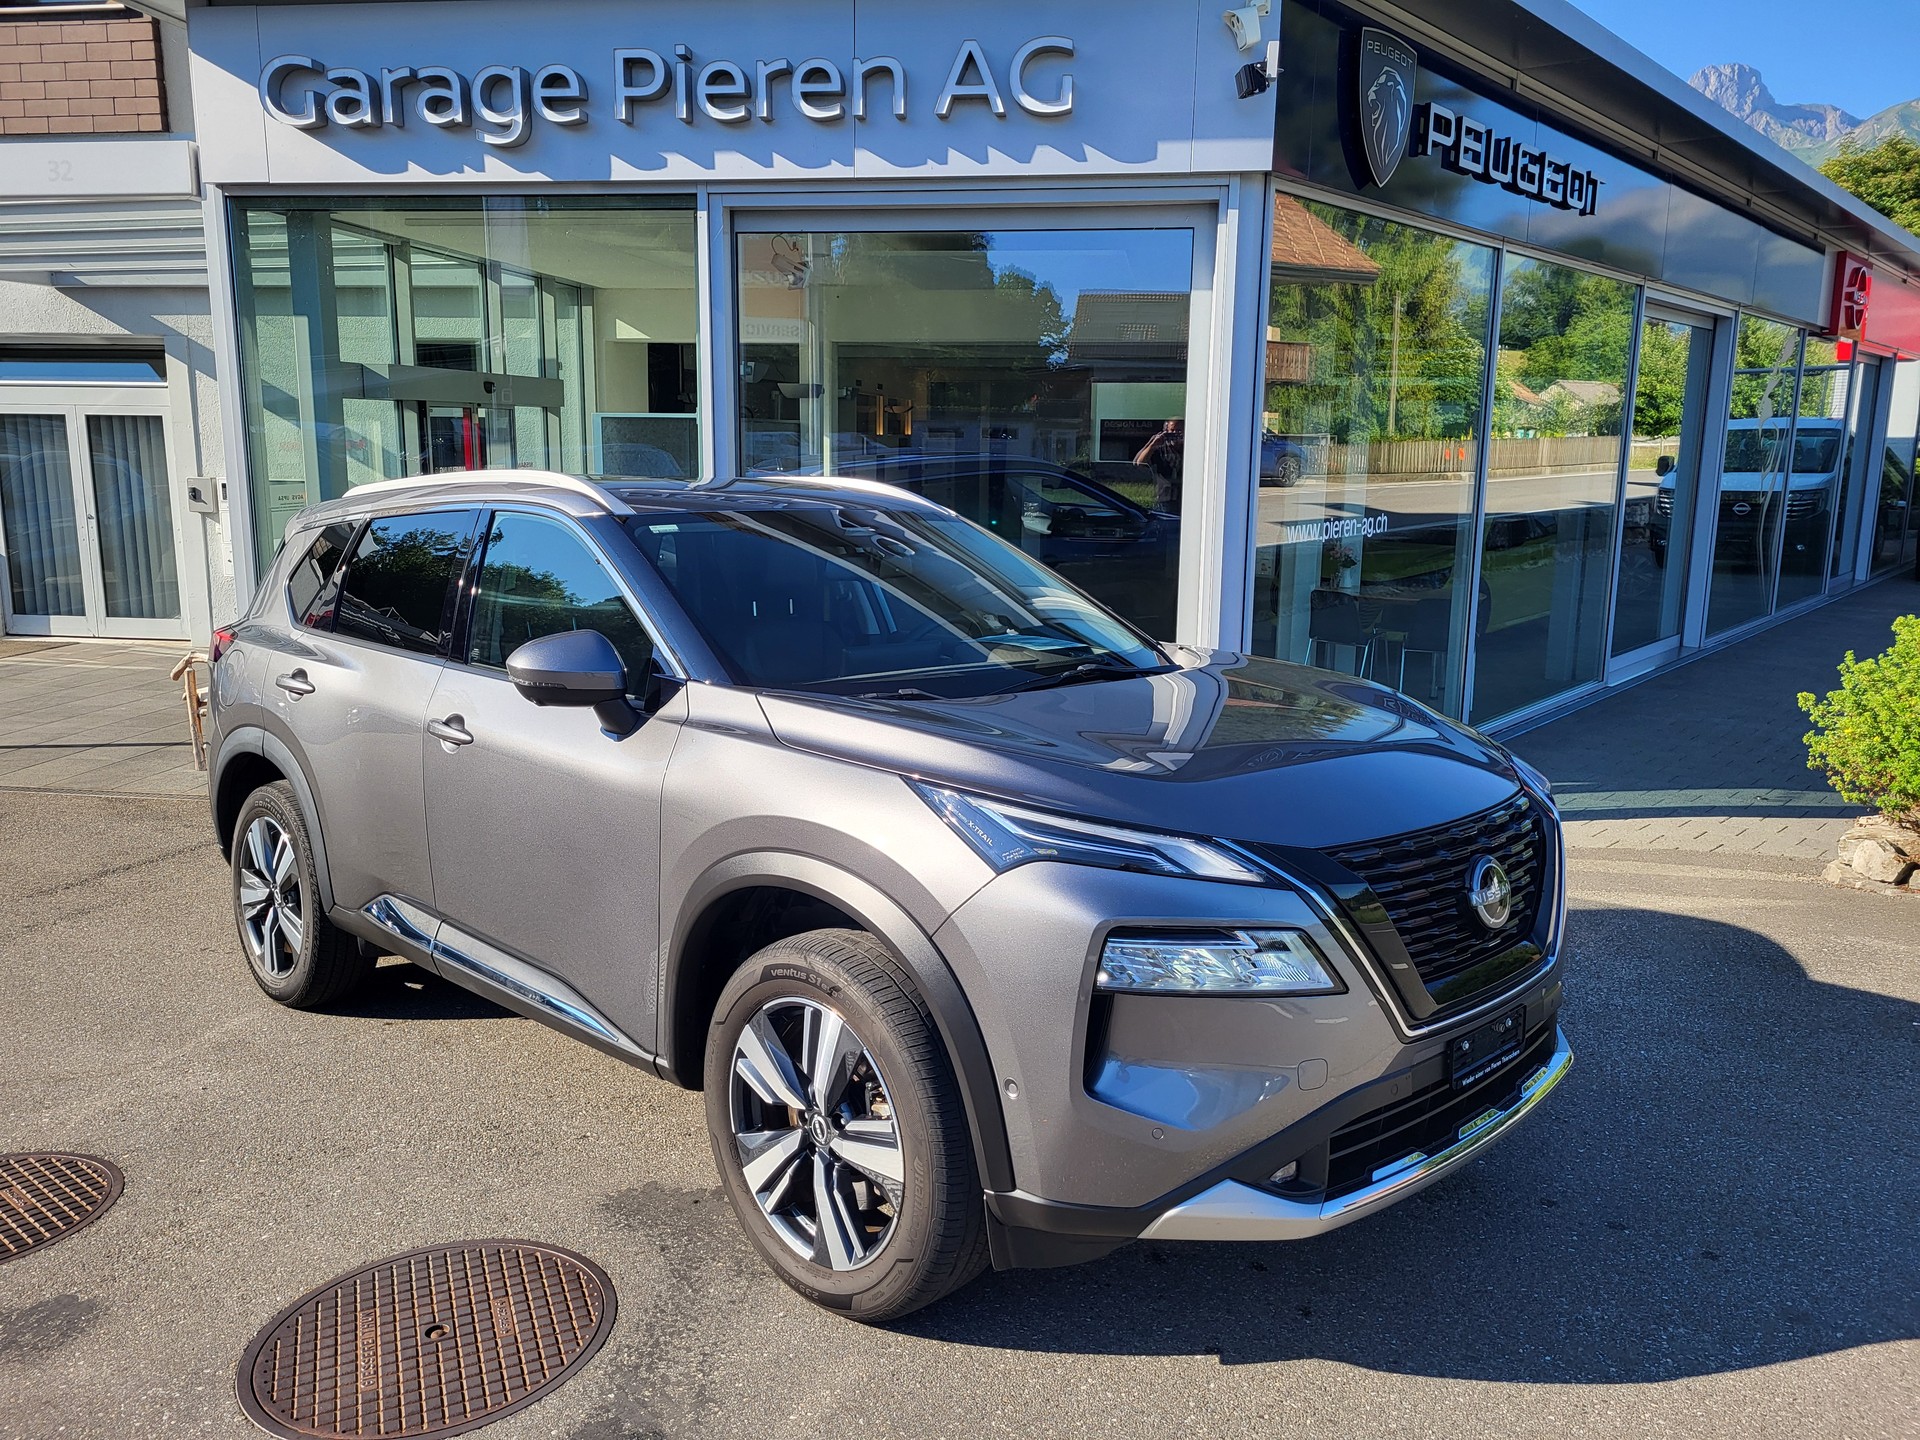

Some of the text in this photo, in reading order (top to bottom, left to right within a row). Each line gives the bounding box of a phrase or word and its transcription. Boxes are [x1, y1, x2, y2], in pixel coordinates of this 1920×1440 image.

[1366, 40, 1413, 69] PEUGEOT
[257, 35, 1075, 148] Garage Pieren AG
[48, 160, 73, 181] 32
[1287, 513, 1388, 543] www.pieren-ag.ch
[968, 820, 993, 847] X-TRAIL
[1472, 883, 1510, 905] NISSAN
